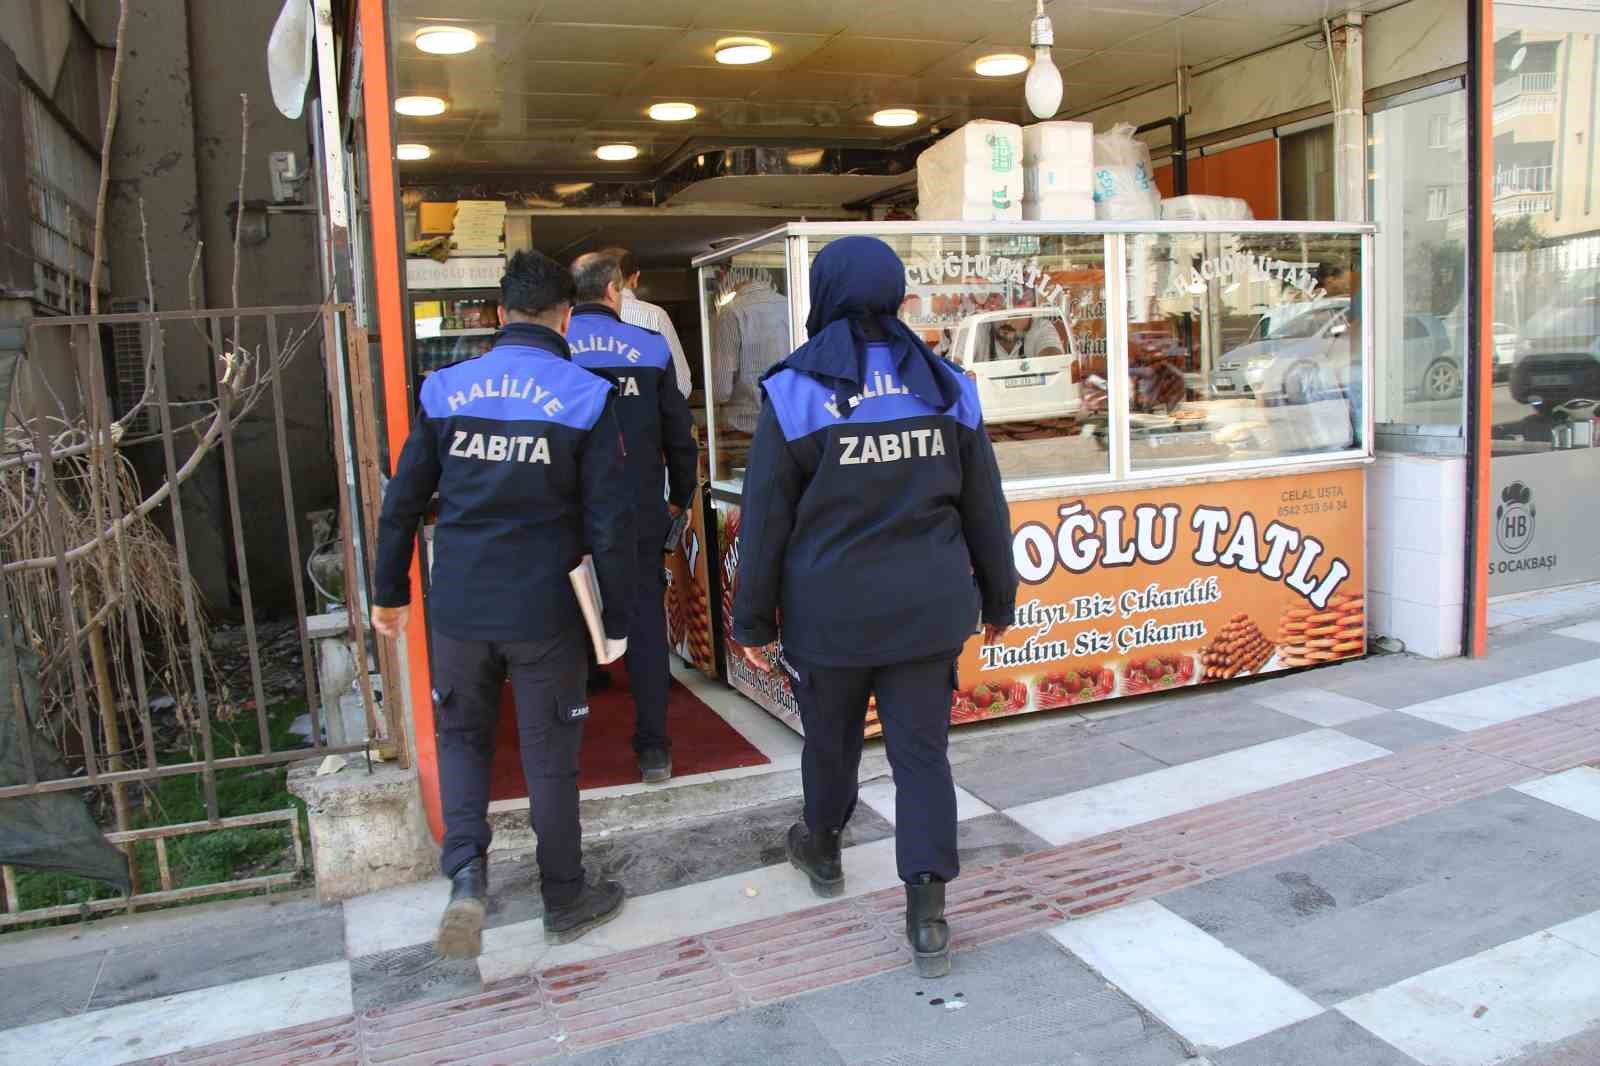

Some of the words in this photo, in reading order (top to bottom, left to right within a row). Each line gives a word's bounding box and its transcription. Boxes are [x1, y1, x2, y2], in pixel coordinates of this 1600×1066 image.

[448, 373, 565, 418] HALİLİYE
[449, 430, 551, 465] ZABITA
[839, 428, 946, 466] ZABITA
[1280, 489, 1316, 502] CELAL
[1318, 486, 1345, 498] USTA
[1505, 515, 1527, 539] HB
[1192, 504, 1351, 610] TATLI
[1498, 555, 1557, 575] OCAKBAŞI
[1072, 593, 1114, 622] Biz
[1120, 577, 1219, 619] Çıkardık
[982, 637, 1068, 671] Tadını
[1074, 629, 1110, 657] Siz
[1117, 621, 1205, 653] Çıkarın
